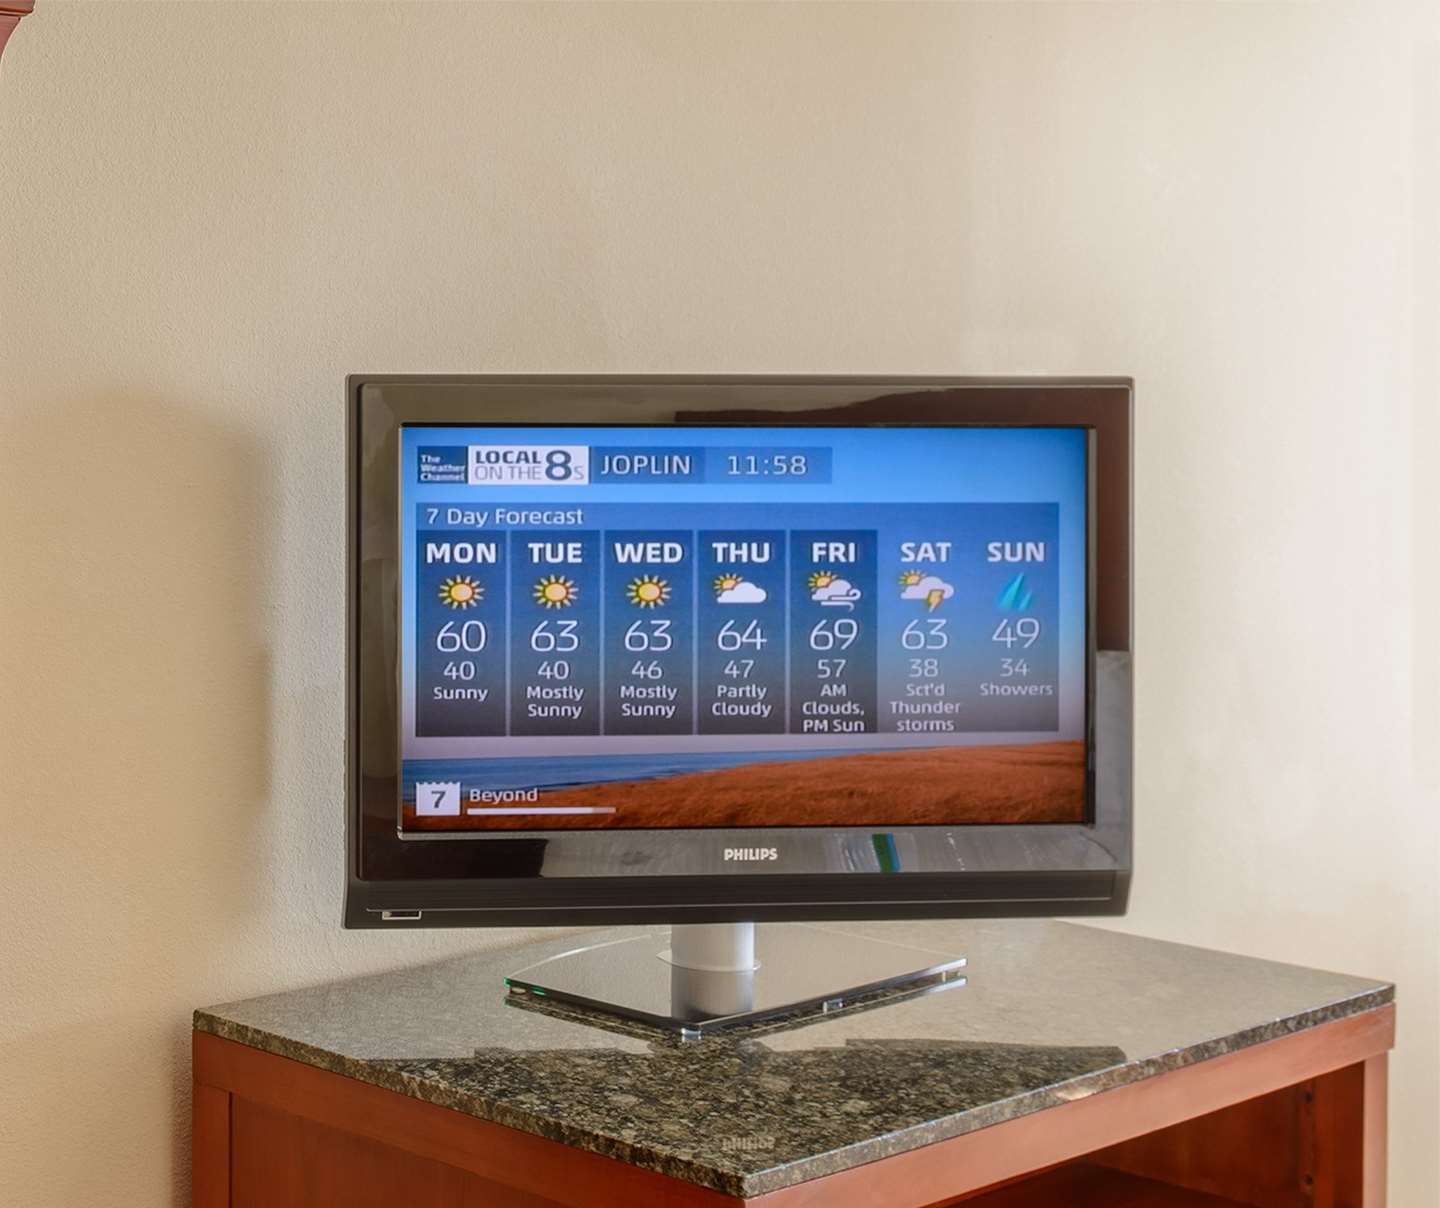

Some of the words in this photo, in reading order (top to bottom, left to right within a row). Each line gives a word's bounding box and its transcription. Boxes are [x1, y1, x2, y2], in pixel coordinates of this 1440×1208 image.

[475, 450, 542, 464] LOCAL
[600, 455, 692, 475] JOPLIN
[726, 455, 807, 475] 11:58
[475, 465, 503, 480] ON
[506, 465, 542, 480] THE
[426, 507, 439, 525] 7
[446, 507, 489, 529] Day
[494, 507, 583, 525] Forecast
[426, 543, 496, 564] MON
[528, 543, 582, 563] TUE
[614, 543, 683, 563] WED
[712, 542, 771, 563] THU
[812, 542, 857, 562] FRI
[900, 542, 951, 563] SAT
[986, 542, 1046, 563] SUN
[436, 619, 487, 652] 60
[530, 619, 579, 652] 63
[624, 618, 673, 651] 63
[717, 618, 768, 650] 64
[809, 617, 858, 650] 69
[901, 617, 949, 650] 63
[991, 617, 1040, 649] 49
[443, 661, 476, 680] 40
[537, 661, 570, 680] 40
[631, 660, 663, 679] 46
[723, 660, 755, 679] 47
[816, 659, 846, 678] 57
[909, 659, 939, 678] 38
[1000, 658, 1031, 677] 34
[433, 686, 488, 702] Sunny
[526, 685, 584, 703] Mostly
[619, 684, 678, 703] Mostly
[716, 684, 767, 702] Partly
[820, 684, 847, 697] AM
[906, 682, 945, 697] Sct'd
[979, 681, 1053, 697] Showers
[527, 703, 582, 720] Sunny
[621, 702, 676, 720] Sunny
[712, 701, 772, 719] Cloudy
[802, 701, 865, 718] Clouds,
[890, 700, 961, 716] Thunder
[802, 718, 832, 732] PM
[832, 718, 865, 732] Sun
[897, 717, 954, 732] storms
[431, 791, 446, 808] 7
[470, 787, 539, 806] Beyond
[724, 848, 778, 861] PHILIPS
